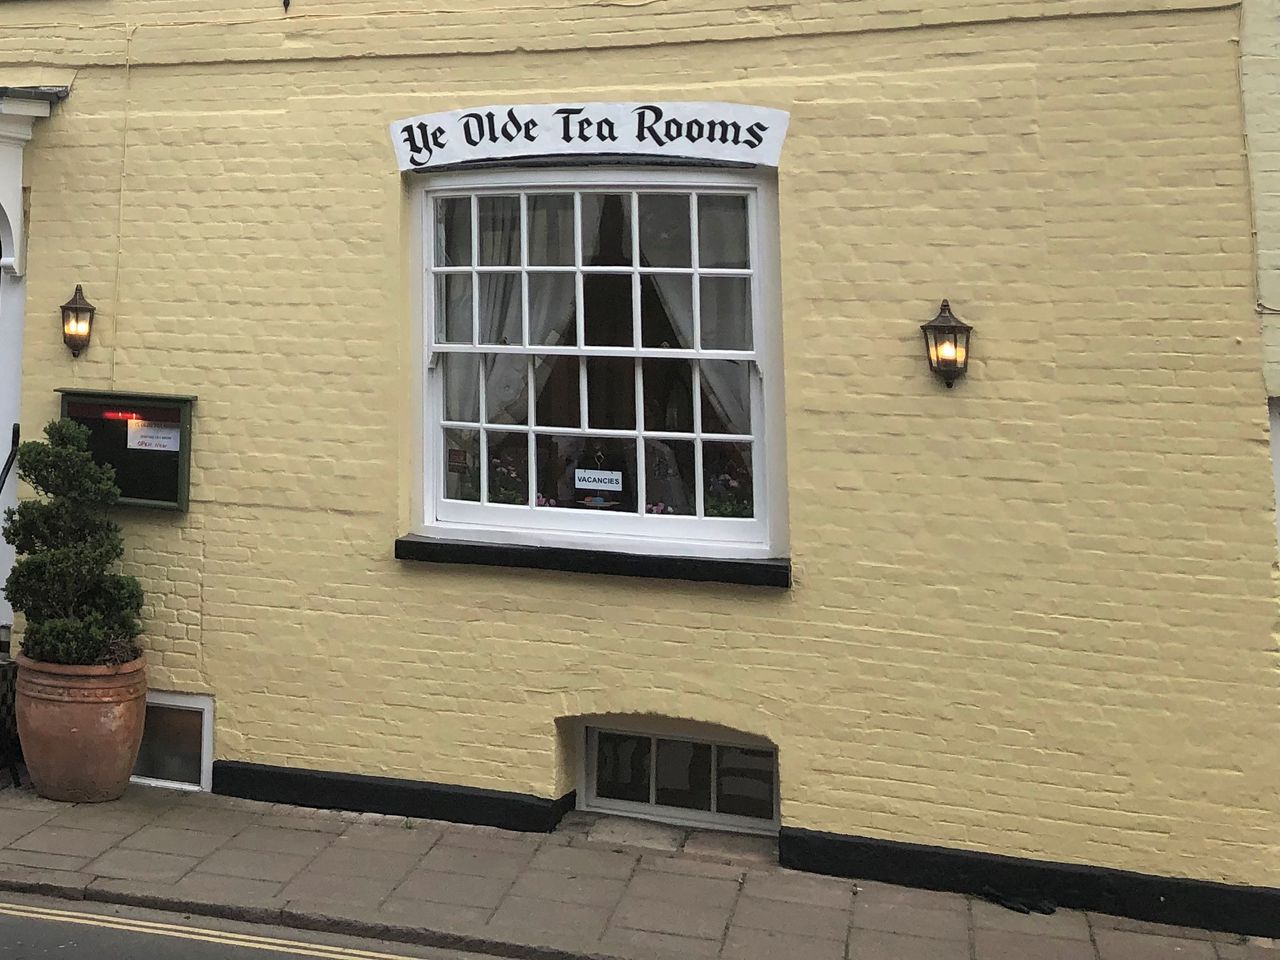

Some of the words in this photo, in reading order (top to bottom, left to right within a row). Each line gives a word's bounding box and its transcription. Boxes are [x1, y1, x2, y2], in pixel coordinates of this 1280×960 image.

[400, 120, 449, 166] Ye
[458, 108, 540, 145] Olde
[552, 106, 619, 143] Tea
[631, 105, 770, 149] Rooms
[577, 476, 620, 485] VACANCIES
